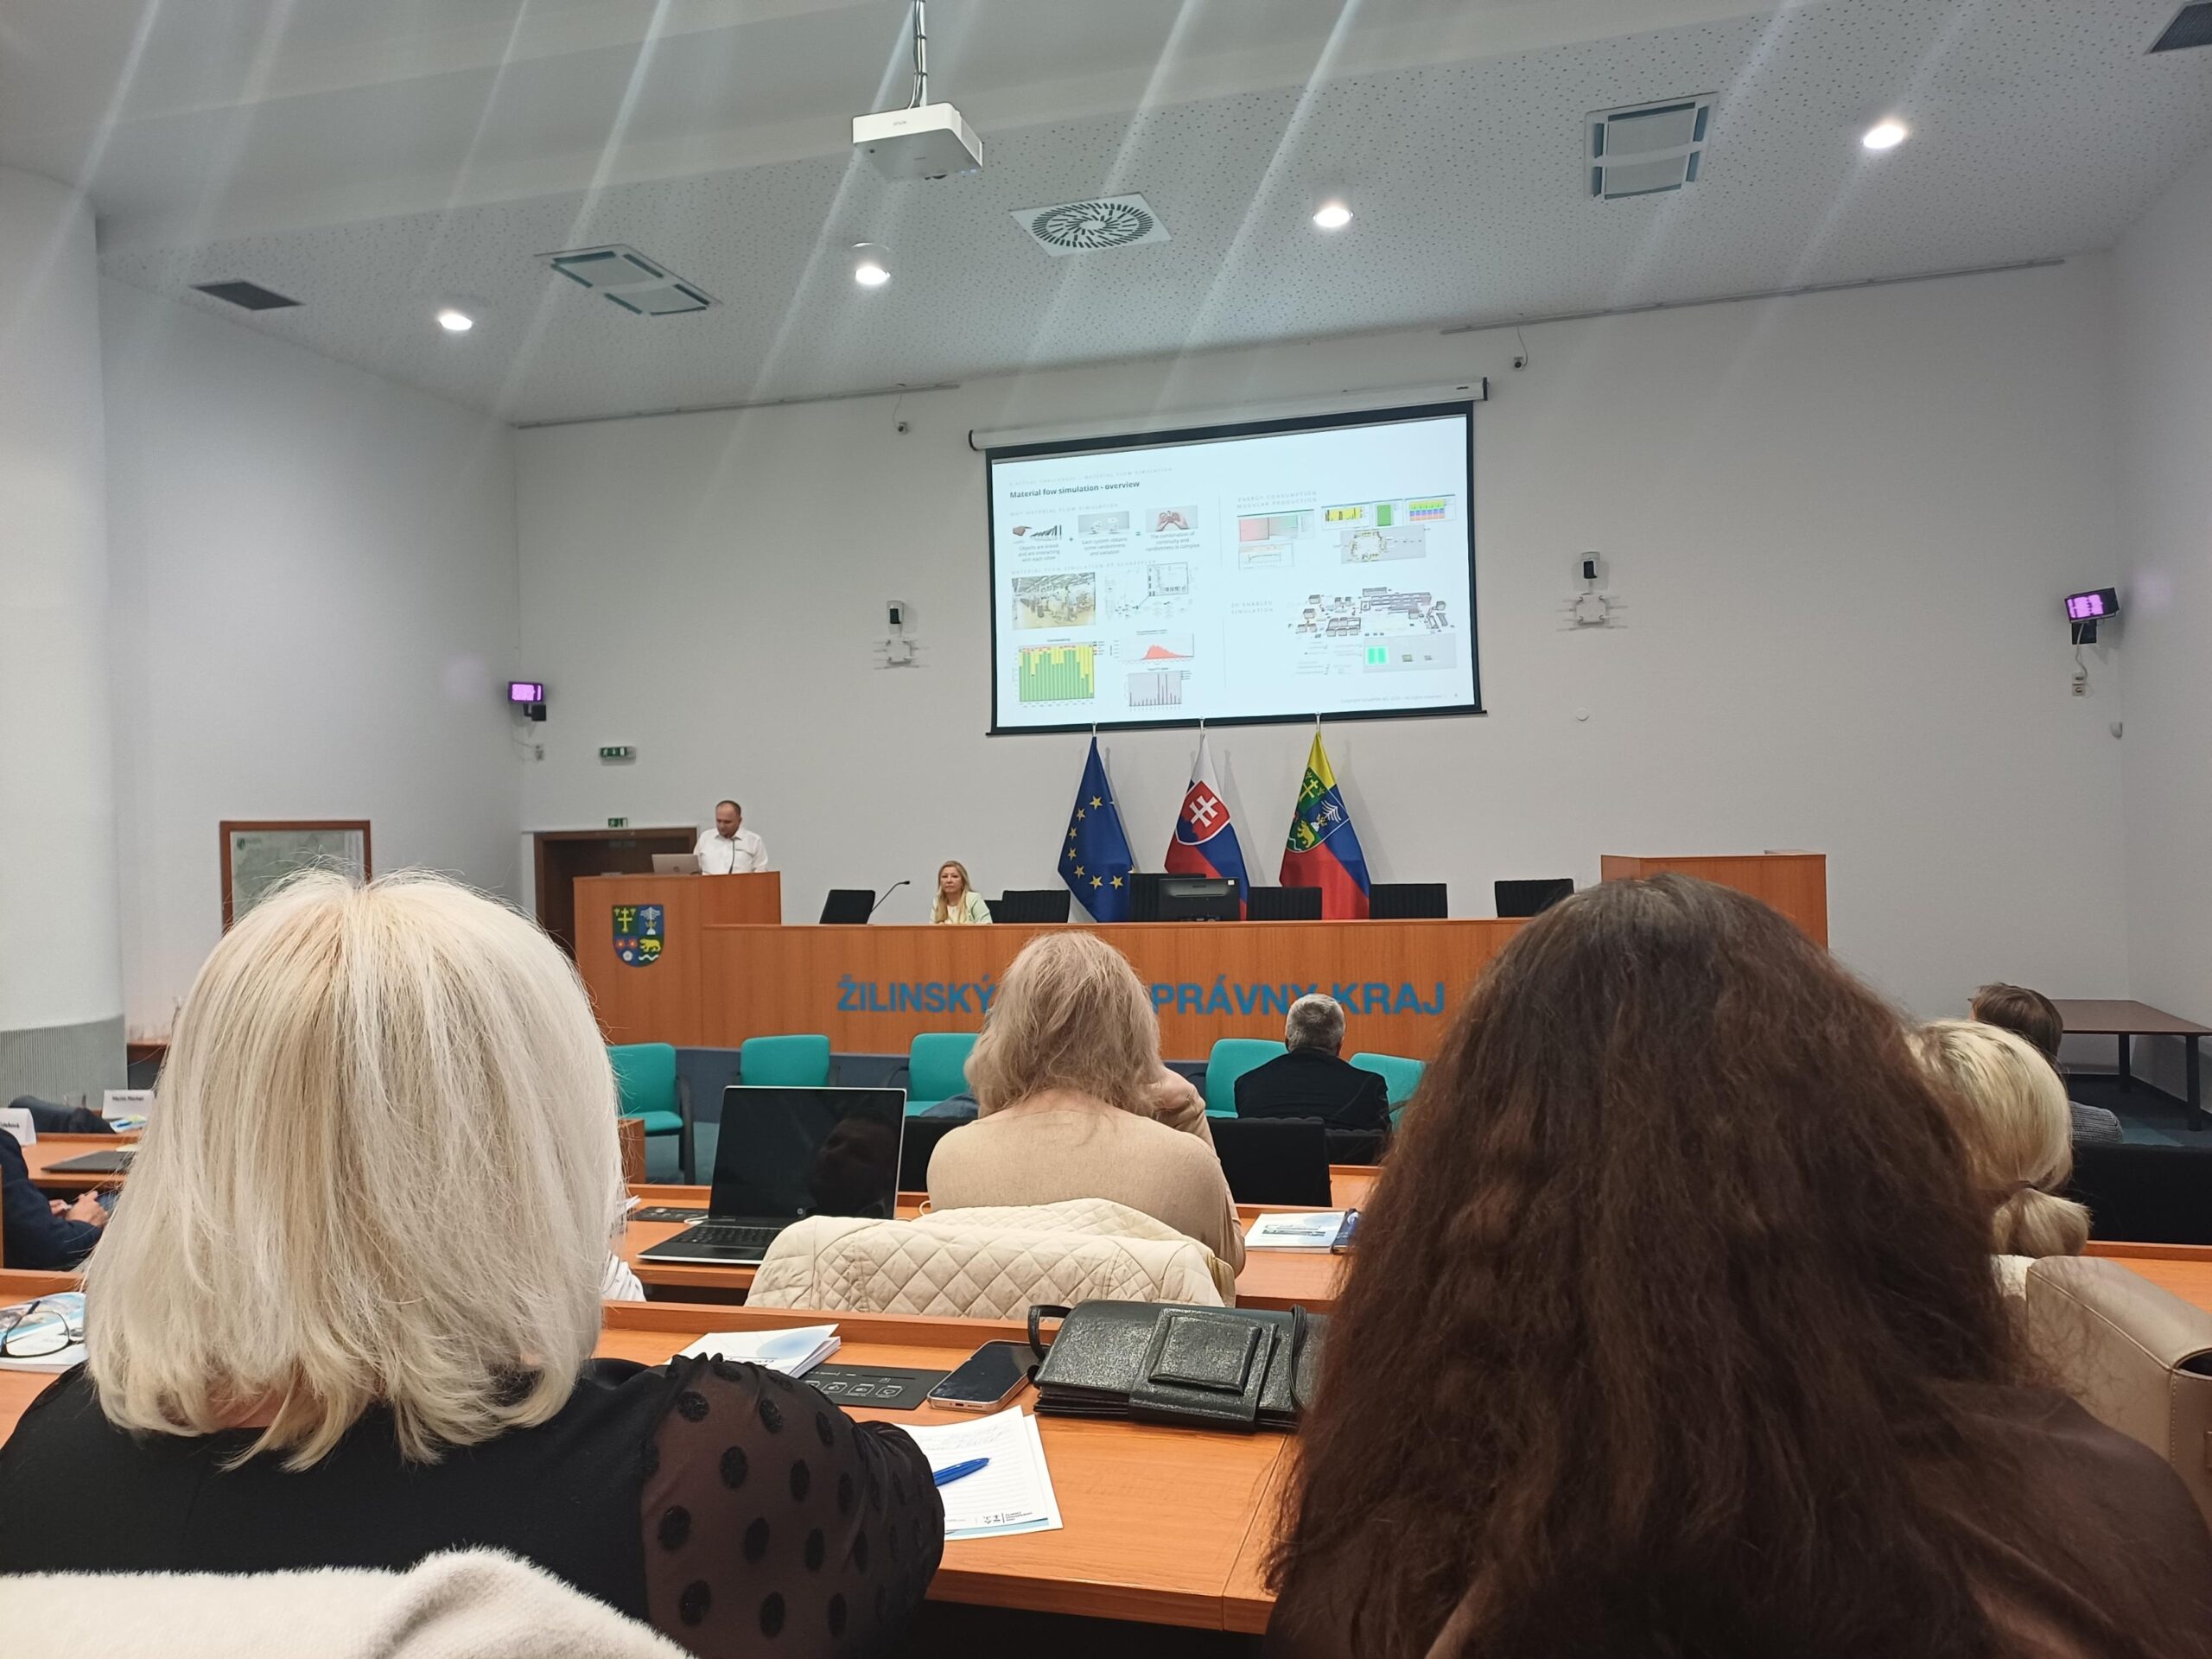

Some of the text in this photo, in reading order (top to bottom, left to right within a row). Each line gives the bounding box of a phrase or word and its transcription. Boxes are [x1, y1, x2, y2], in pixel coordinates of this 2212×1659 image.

[1009, 488, 1041, 499] Material
[1058, 484, 1099, 495] simulation
[1104, 480, 1141, 492] overview
[836, 973, 996, 1014] ŽILINSKÝ
[1332, 982, 1446, 1016] KRAJ
